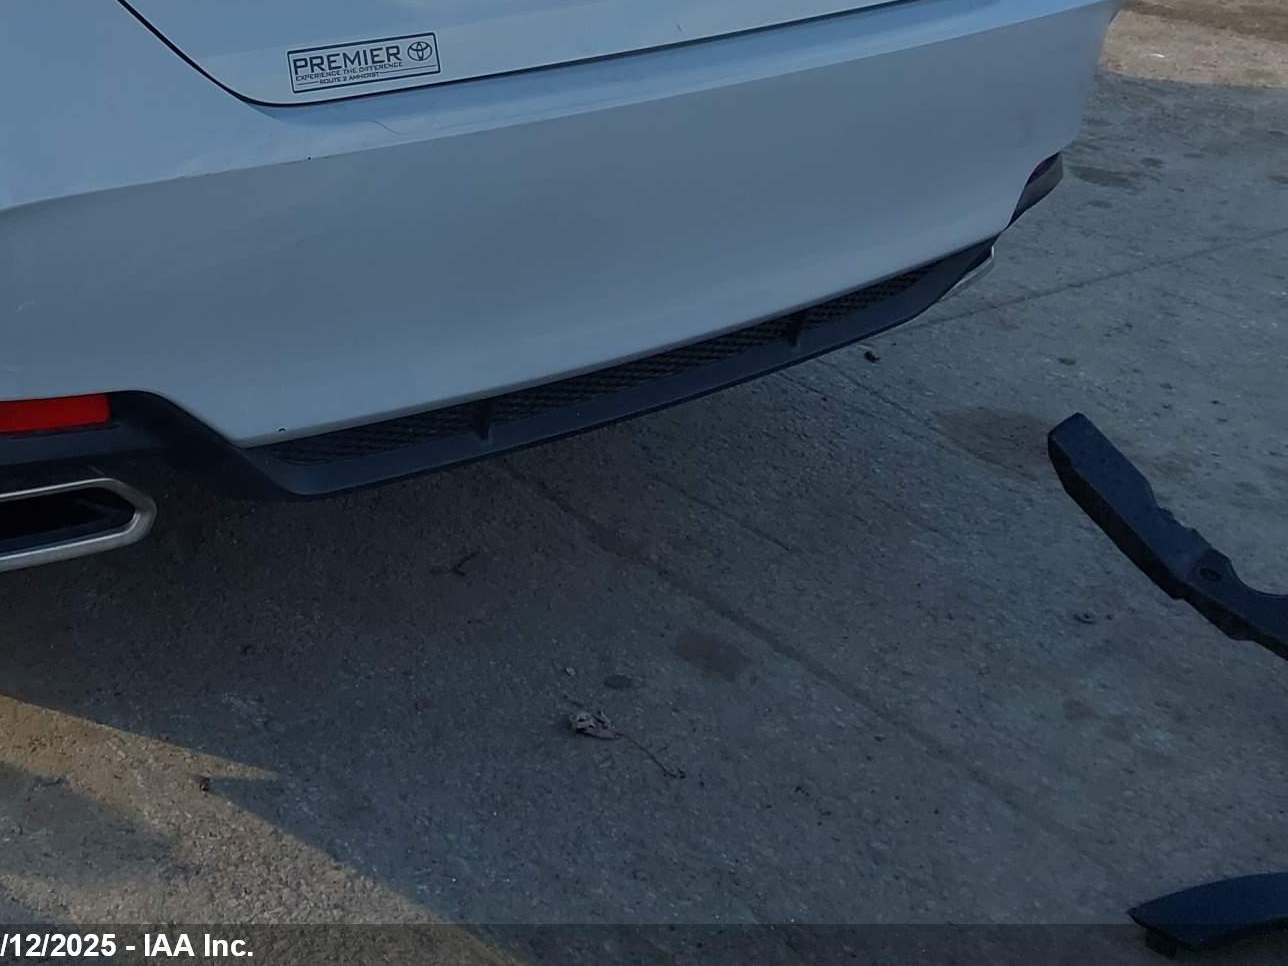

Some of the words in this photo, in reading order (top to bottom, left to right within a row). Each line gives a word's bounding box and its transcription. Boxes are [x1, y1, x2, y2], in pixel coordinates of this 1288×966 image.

[292, 45, 403, 75] PREMIER
[295, 70, 341, 82] EXPERIENCE
[343, 68, 357, 76] THE
[358, 62, 403, 74] DIFFERENCE
[319, 76, 341, 85] ROUTE
